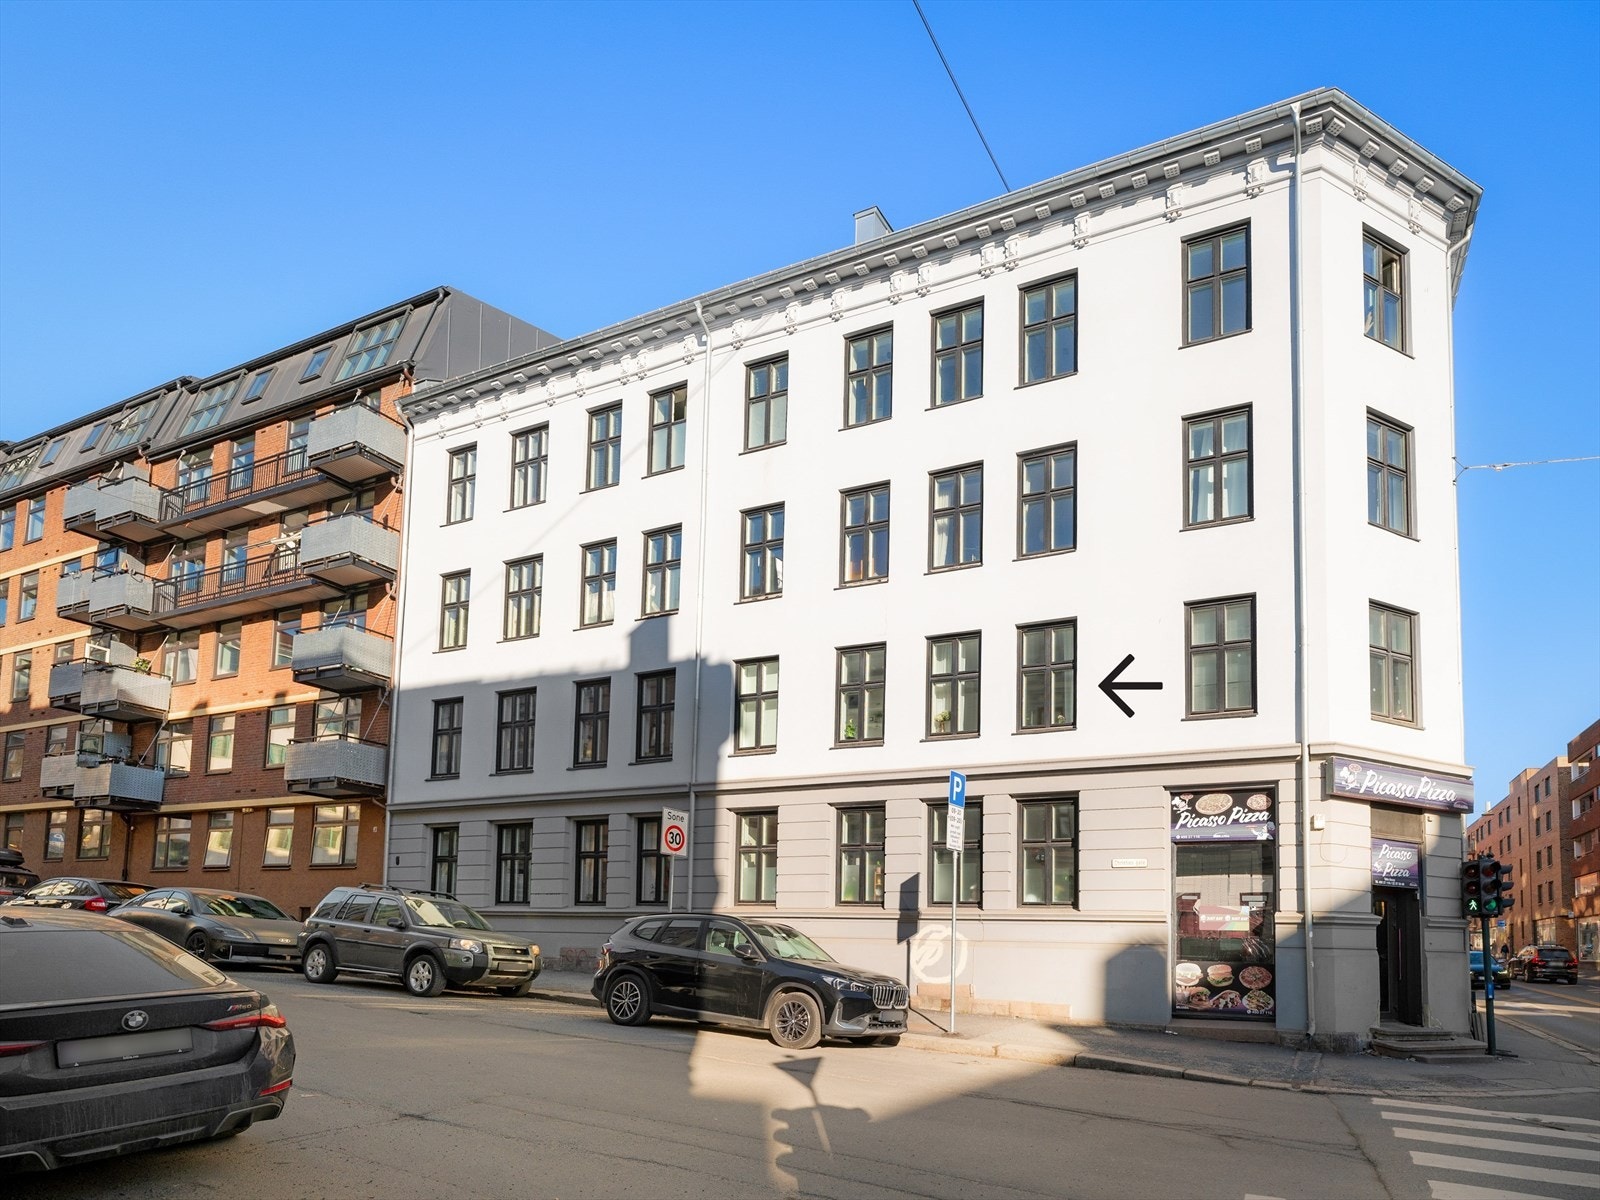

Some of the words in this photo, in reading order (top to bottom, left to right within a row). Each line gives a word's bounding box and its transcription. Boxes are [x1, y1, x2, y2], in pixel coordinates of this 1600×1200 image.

[953, 776, 962, 800] P
[1359, 769, 1414, 799] Picasso
[1415, 776, 1457, 801] Pizza
[667, 812, 684, 822] Sone
[1175, 811, 1227, 830] Picasso
[1227, 806, 1271, 825] Pizza
[668, 832, 681, 845] 30
[1379, 843, 1412, 861] Picasso
[1382, 862, 1411, 877] Pizza
